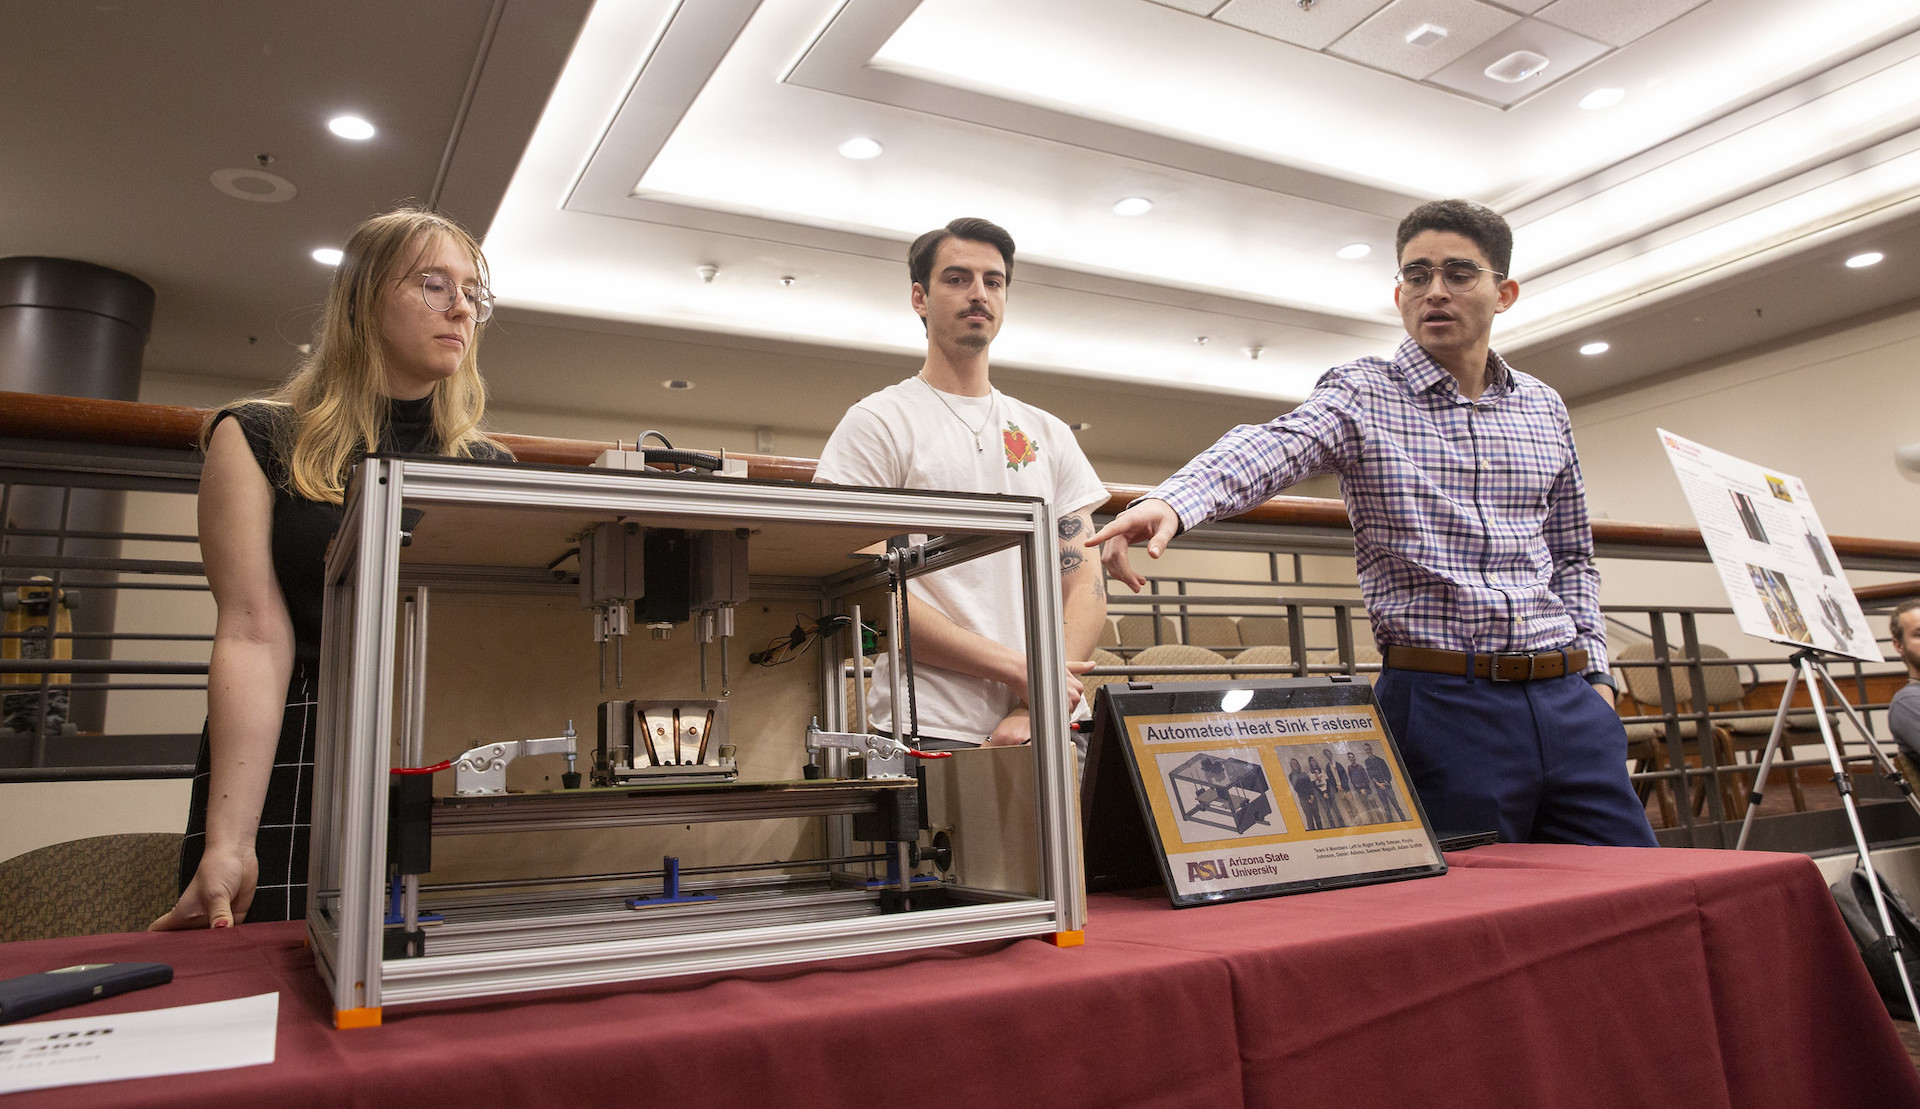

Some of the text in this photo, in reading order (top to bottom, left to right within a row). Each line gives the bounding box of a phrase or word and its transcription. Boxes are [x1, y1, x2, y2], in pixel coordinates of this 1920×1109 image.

[1147, 716, 1373, 742] Automated Heat Sink Fastener
[1229, 852, 1290, 867] Arizona State
[1186, 858, 1230, 883] ASU
[1231, 865, 1278, 878] University
